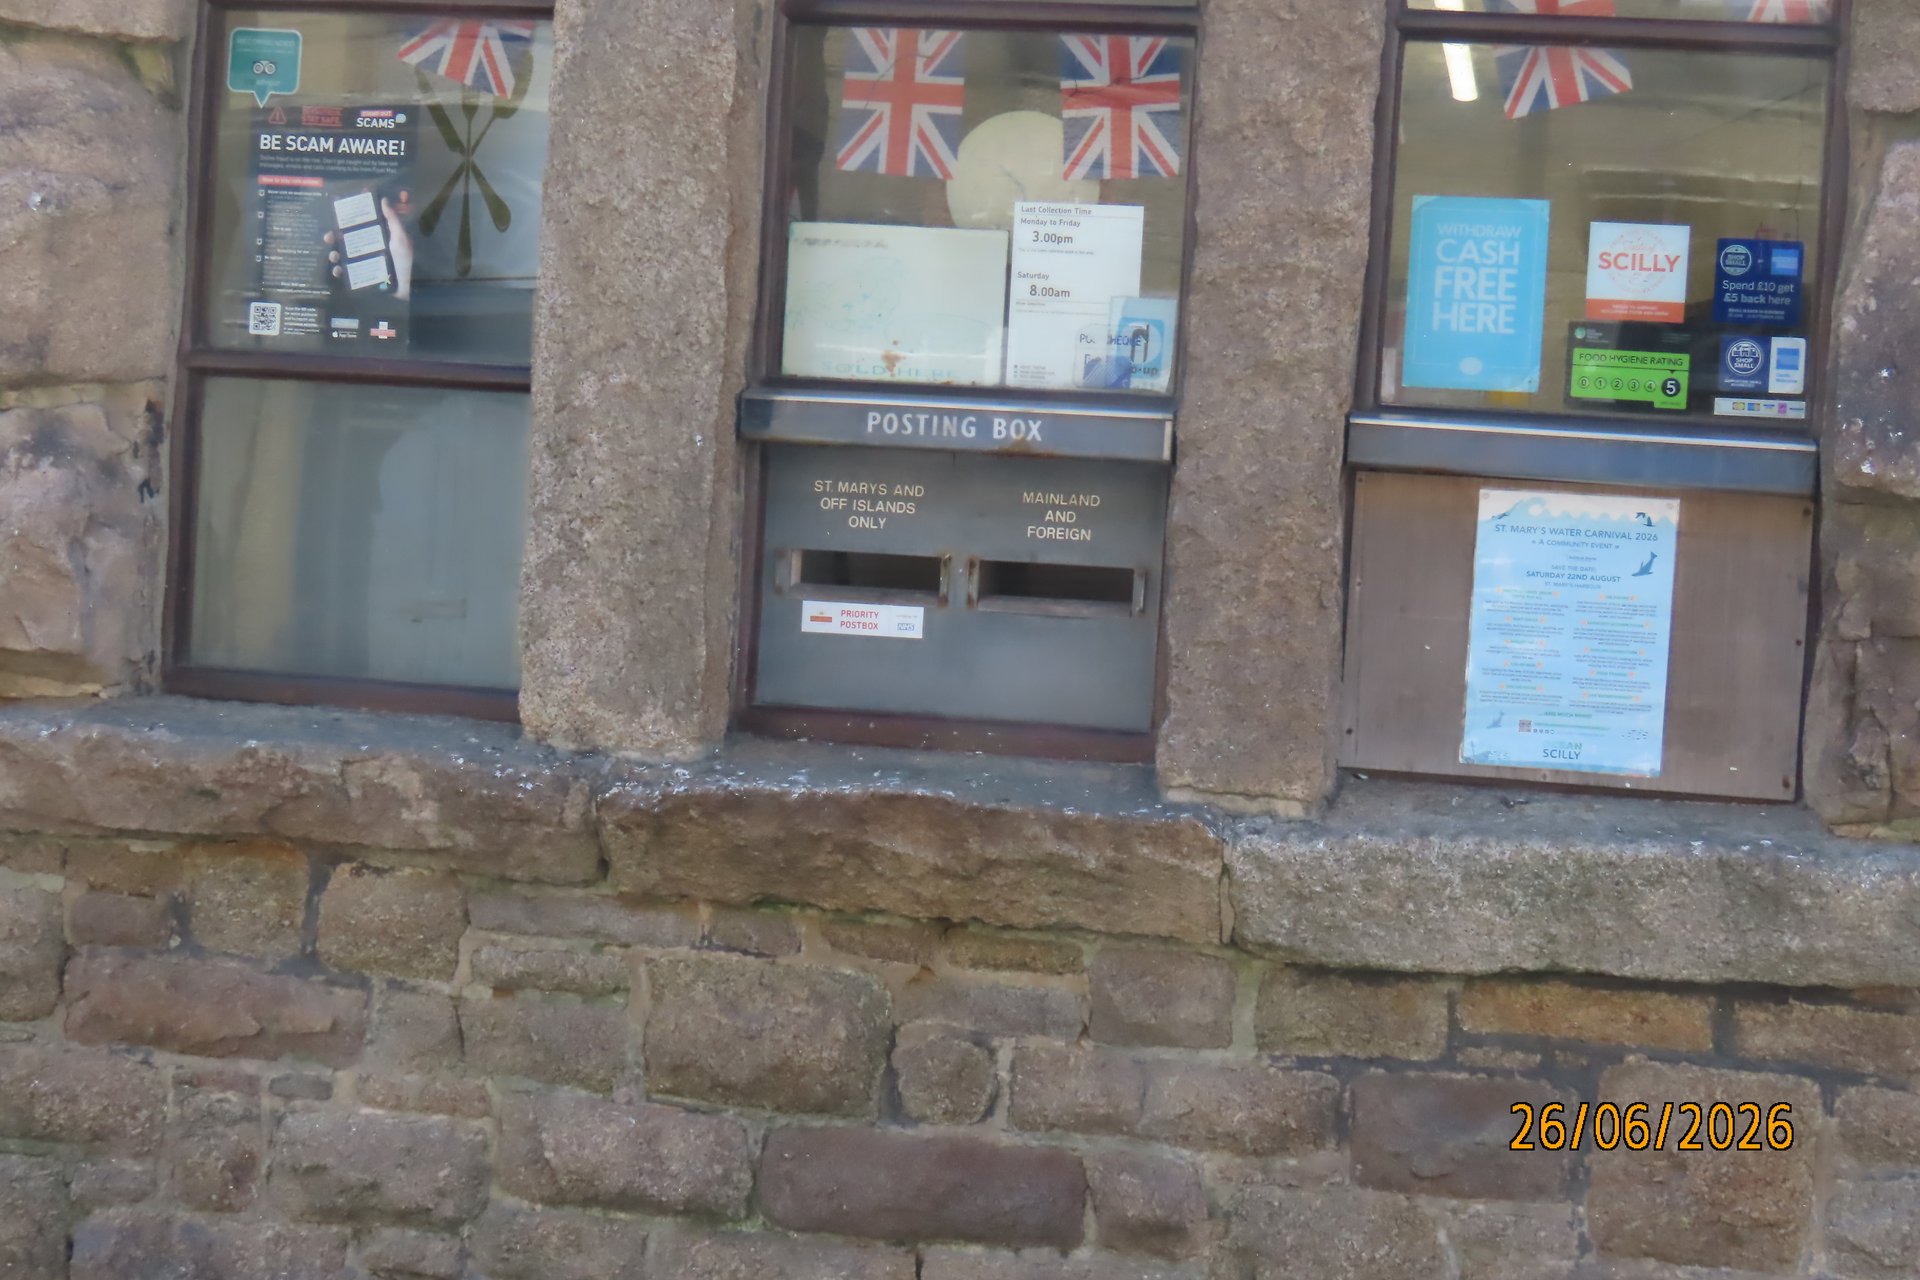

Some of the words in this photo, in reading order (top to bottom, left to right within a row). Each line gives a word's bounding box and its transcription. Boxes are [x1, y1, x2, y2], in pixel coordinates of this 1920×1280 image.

[356, 118, 395, 129] SCAMS
[260, 134, 282, 150] BE
[286, 136, 334, 152] SCAM
[338, 138, 406, 156] AWARE!
[1021, 206, 1036, 214] Last
[1038, 206, 1072, 214] Collection
[1074, 208, 1092, 216] Time
[1020, 218, 1047, 227] Monday
[1059, 218, 1081, 228] Friday
[1032, 230, 1074, 246] 3.00pm
[1436, 224, 1522, 238] WITHDRAW
[1436, 238, 1521, 266] CASH
[1598, 252, 1681, 272] SCILLY
[1017, 271, 1050, 281] Saturday
[1434, 265, 1519, 302] FREE
[1722, 280, 1755, 291] Spend
[1756, 282, 1776, 292] £10
[1778, 284, 1795, 294] get
[1029, 284, 1070, 298] 8.00am
[1724, 292, 1738, 302] £5
[1740, 294, 1766, 304] back
[1768, 294, 1792, 305] here
[1432, 301, 1517, 335] HERE
[1580, 353, 1607, 362] FOOD
[1609, 355, 1648, 365] HYGIENE
[1650, 357, 1684, 366] RATING
[822, 361, 887, 376] SOLD
[867, 412, 976, 438] POSTING
[992, 418, 1042, 442] BOX
[838, 482, 888, 496] MARYS
[894, 484, 925, 498] AND
[820, 497, 848, 510] OFF
[852, 500, 916, 514] ISLANDS
[1022, 492, 1101, 507] MAINLAND
[848, 516, 887, 529] ONLY
[1044, 510, 1077, 523] AND
[1027, 526, 1092, 541] FOREIGN
[1510, 526, 1546, 535] MARY'S
[1550, 528, 1582, 538] WATER
[1584, 529, 1632, 540] CARNIVAL
[1635, 532, 1659, 542] 2026
[1546, 540, 1589, 548] COMMUNITY
[1590, 542, 1613, 550] EVENT
[1526, 570, 1565, 579] SATURDAY
[1590, 574, 1622, 583] AUGUST
[840, 610, 880, 619] PRIORITY
[840, 620, 879, 630] POSTBOX
[1542, 748, 1581, 760] SCILLY
